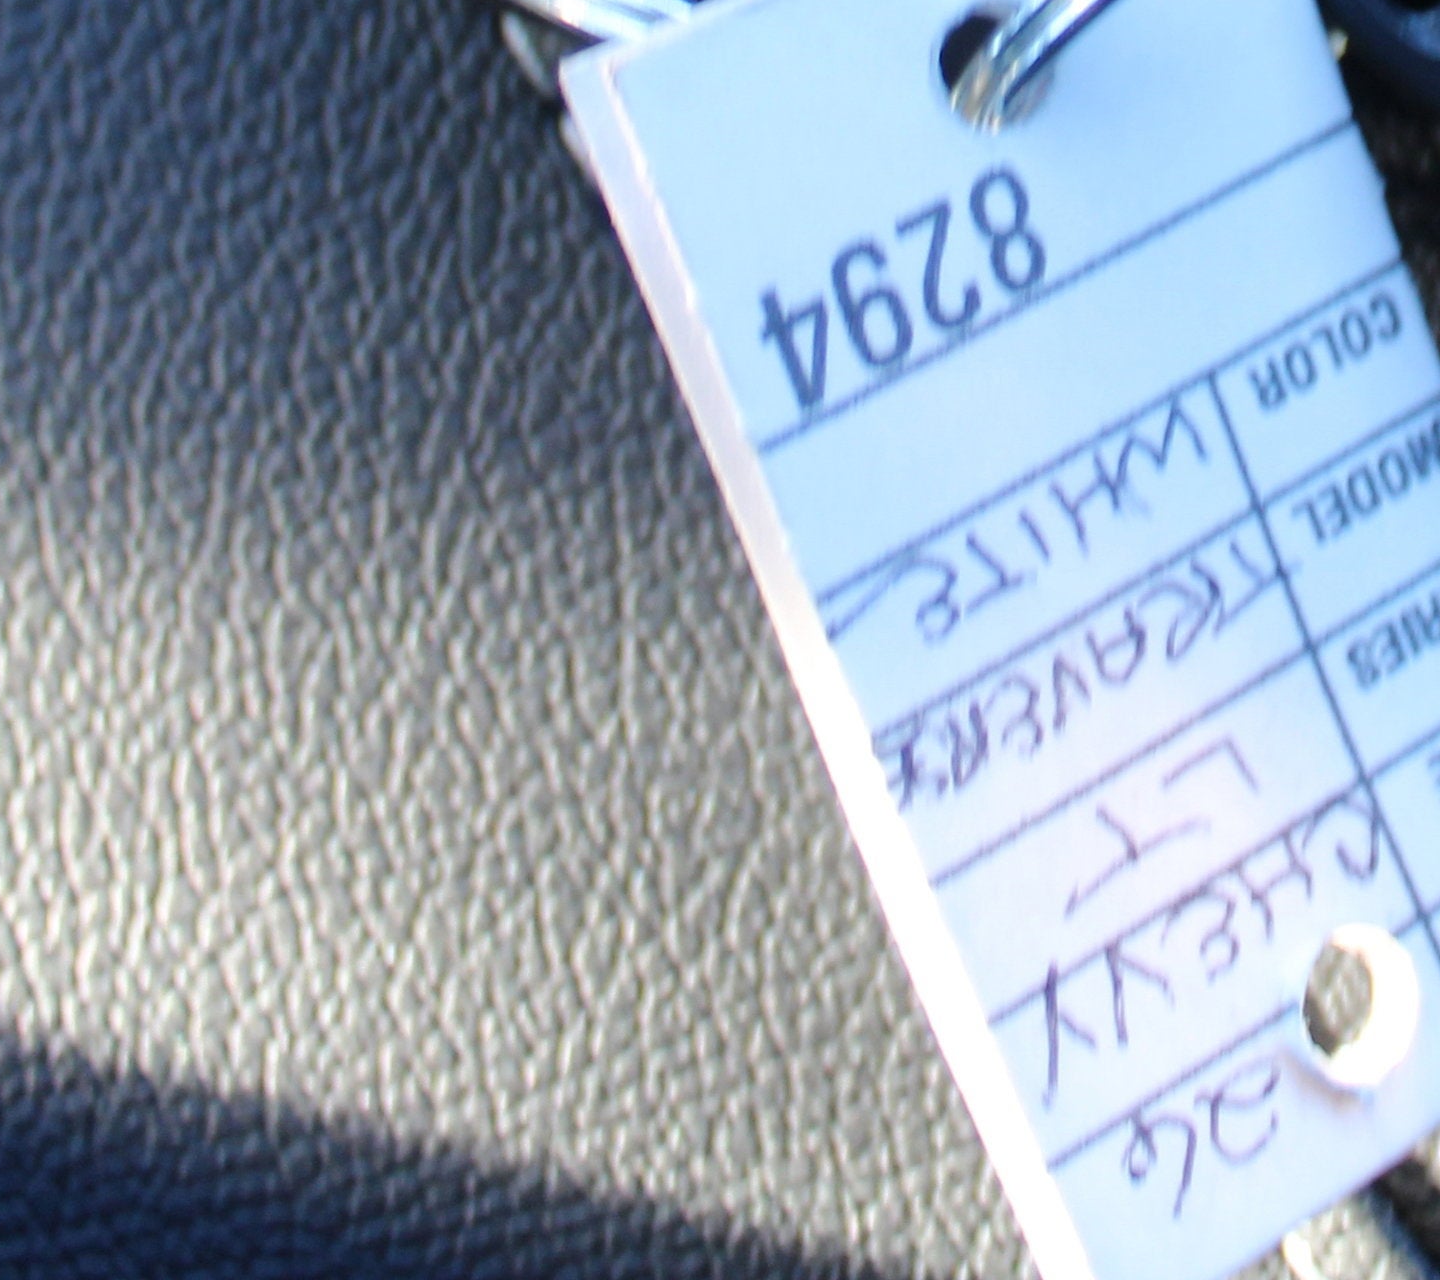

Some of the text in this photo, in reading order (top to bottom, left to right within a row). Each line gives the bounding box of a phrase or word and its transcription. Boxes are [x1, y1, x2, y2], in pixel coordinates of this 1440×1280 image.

[761, 164, 1045, 418] 8294
[1249, 294, 1400, 411] COLOR
[825, 398, 1208, 636] WHITE
[1065, 738, 1256, 916] LT
[1042, 786, 1384, 1107] CHEVY
[1122, 1072, 1279, 1218] 26
